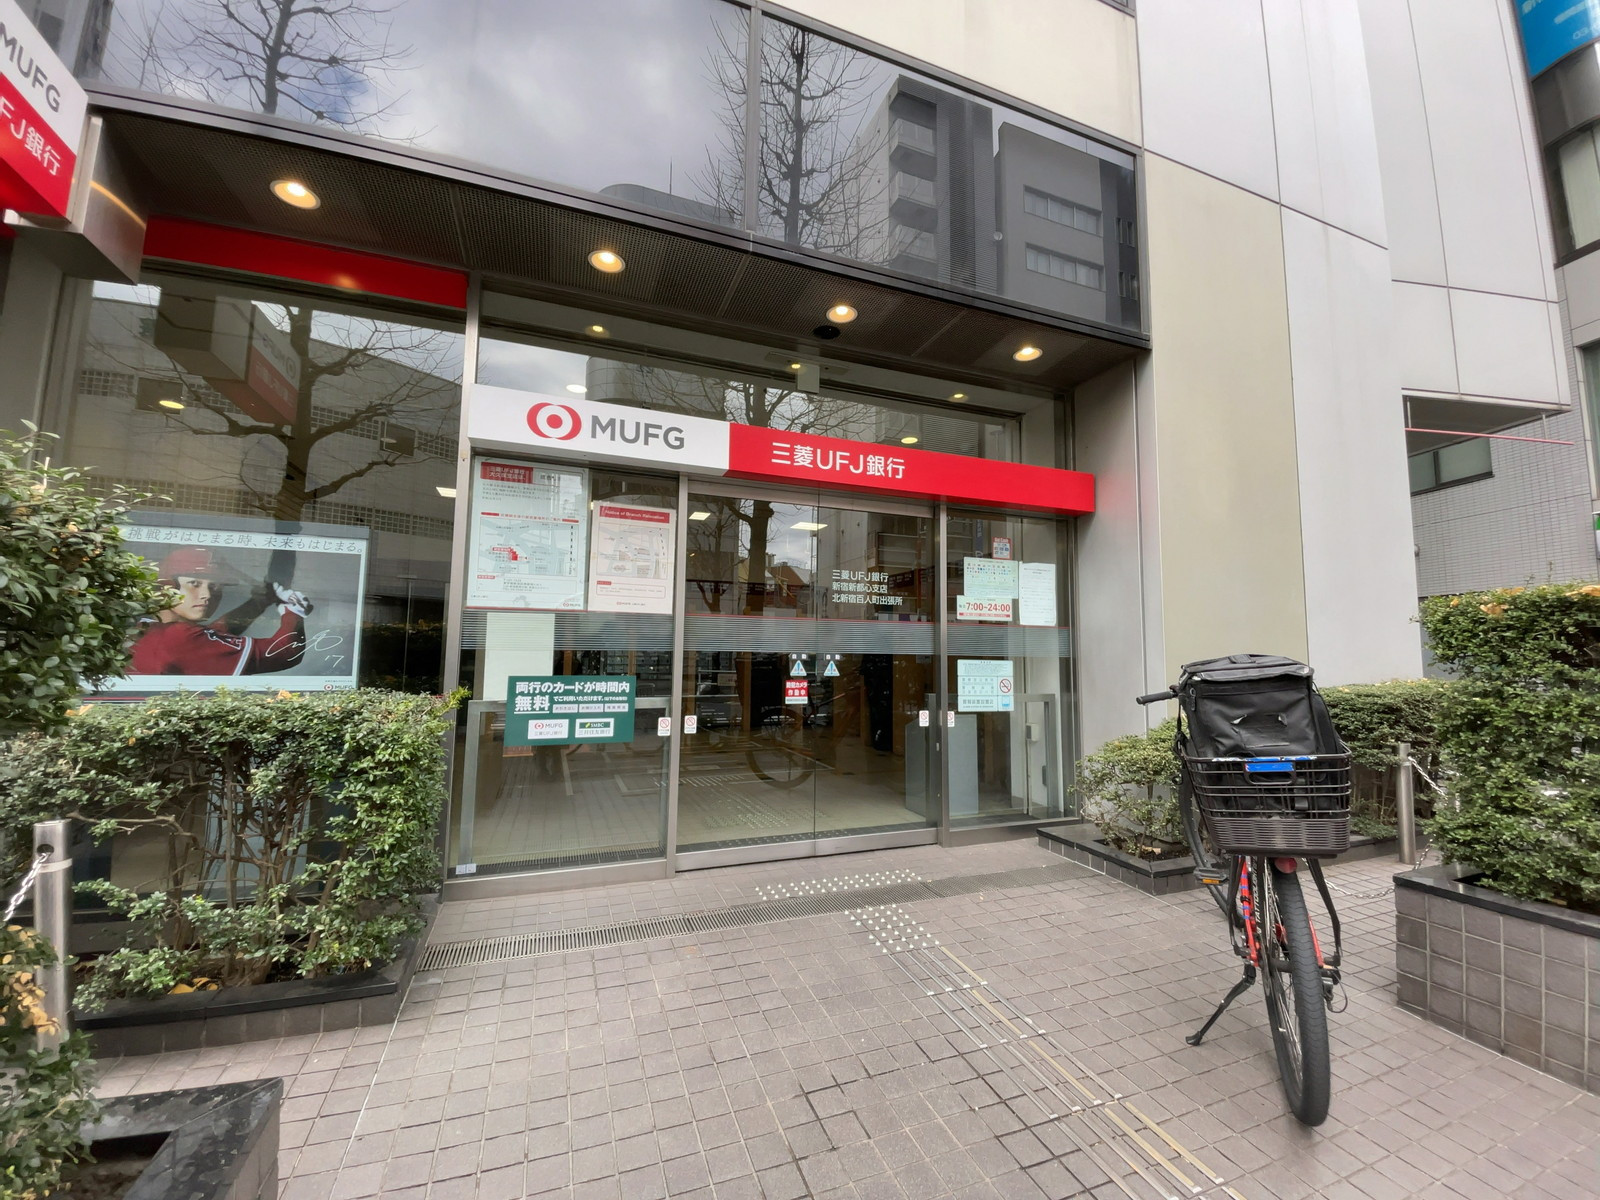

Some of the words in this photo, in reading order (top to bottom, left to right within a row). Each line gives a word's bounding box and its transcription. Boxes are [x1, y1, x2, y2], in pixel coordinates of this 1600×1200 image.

[0, 22, 61, 113] MUFG
[591, 415, 685, 450] MUFG
[771, 442, 905, 479] 三菱UFJ銀行
[127, 527, 363, 553] 挑戦がはじまる時、未来もはじまる。
[832, 569, 889, 583] 三菱UFJ銀行
[832, 582, 888, 594] 新宿新都心支店
[832, 593, 903, 606] 北新宿百人町出張所
[515, 681, 630, 694] 両行のカードが時間内
[514, 695, 550, 711] 無料
